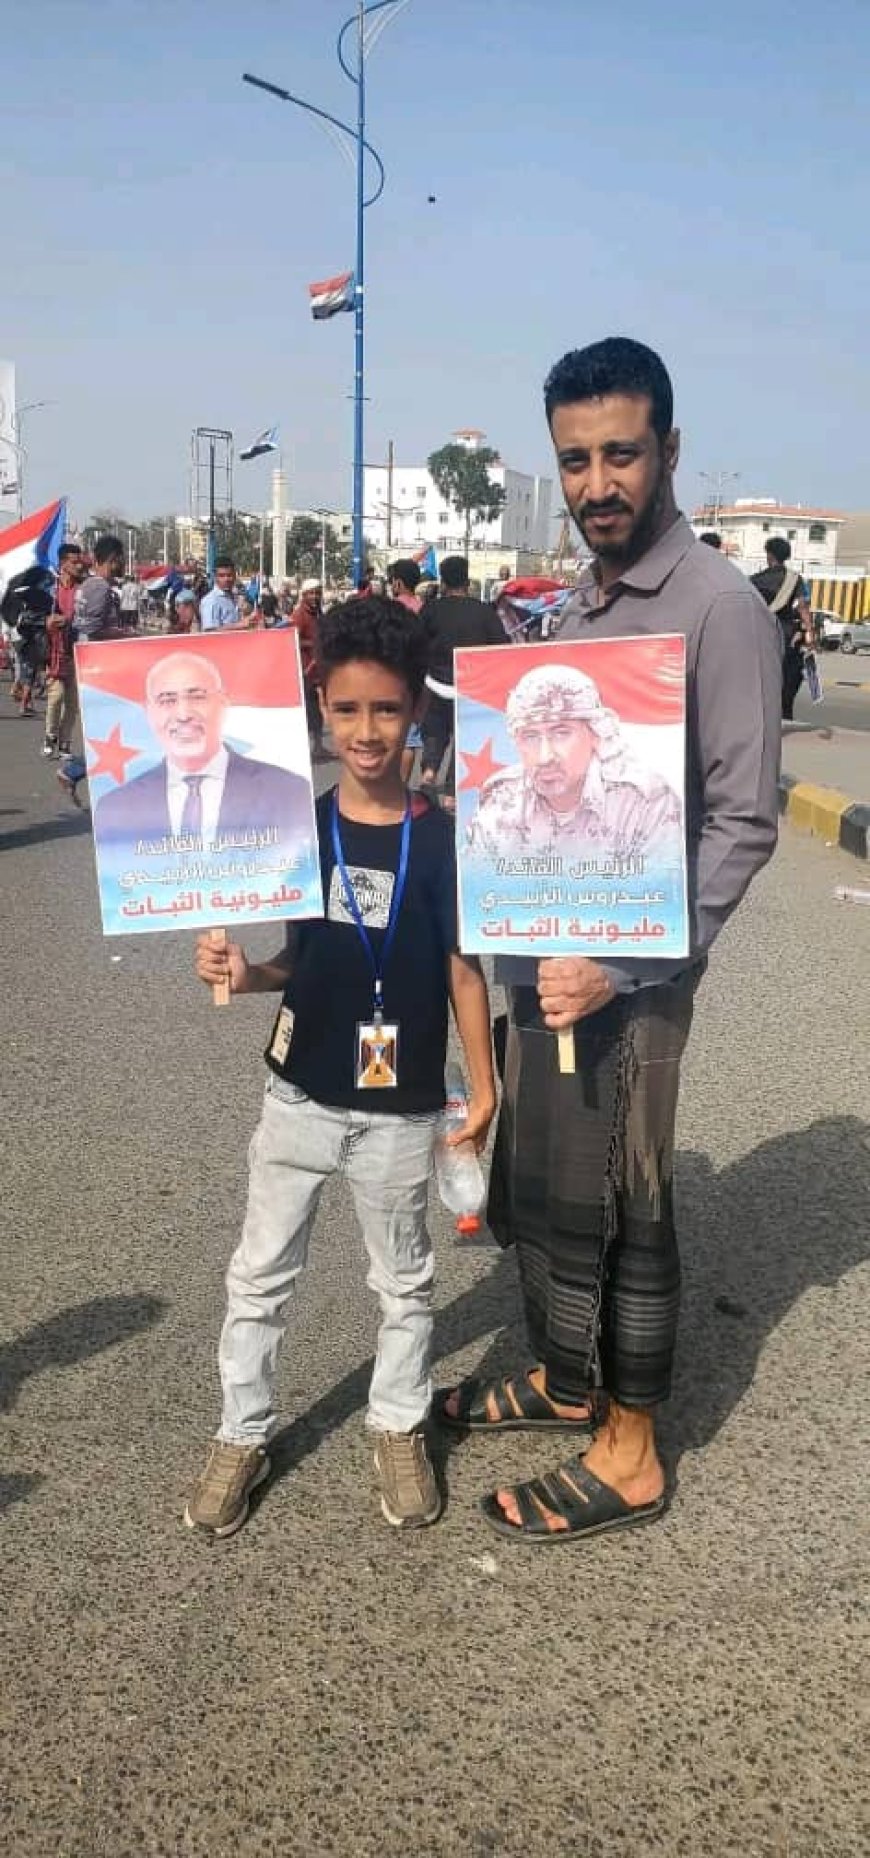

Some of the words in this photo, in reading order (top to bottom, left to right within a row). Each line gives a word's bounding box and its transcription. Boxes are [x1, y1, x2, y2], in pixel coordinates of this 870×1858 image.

[568, 853, 644, 880] الرئيس
[122, 892, 202, 918] الثبات
[210, 884, 303, 912] مليونية
[480, 884, 564, 912] الزبيدي
[566, 889, 664, 908] عيدروس
[481, 917, 560, 942] الثبات
[567, 916, 665, 943] مليونية
